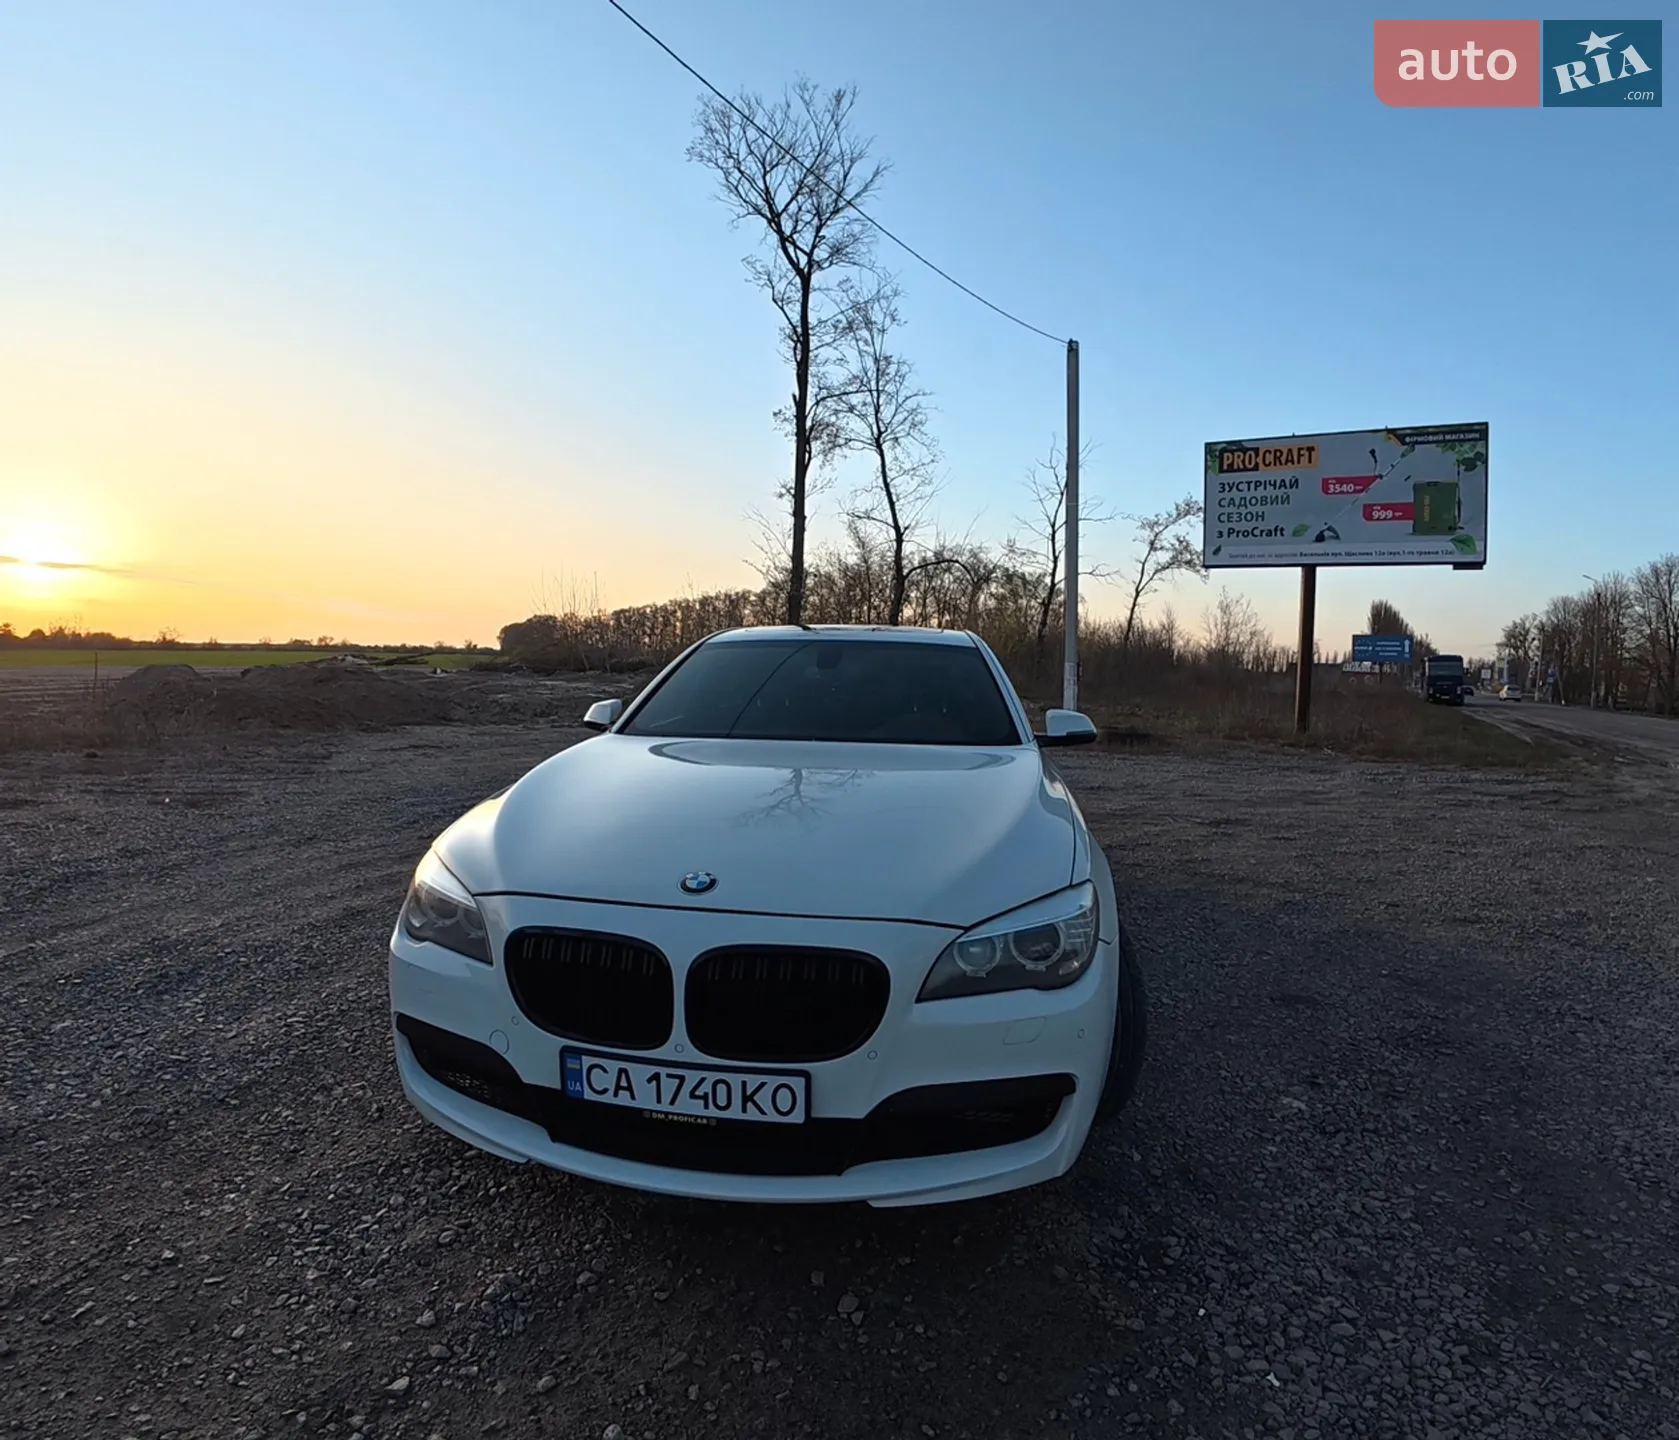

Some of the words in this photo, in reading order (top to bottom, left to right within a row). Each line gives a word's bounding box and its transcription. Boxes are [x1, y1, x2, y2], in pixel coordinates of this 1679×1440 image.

[1223, 450, 1256, 470] PRO
[1262, 446, 1315, 467] CRAFT
[1218, 475, 1299, 493] ЗУСТРІЧАЙ
[1327, 483, 1354, 494] 3540
[1217, 492, 1291, 509] САДОВИЙ
[1217, 511, 1265, 523] СЕЗОН
[1371, 509, 1393, 520] 999
[1227, 525, 1285, 539] ProCraft
[567, 1081, 582, 1092] UA
[585, 1063, 637, 1101] CA
[645, 1071, 732, 1112] 1740
[741, 1080, 798, 1118] KO
